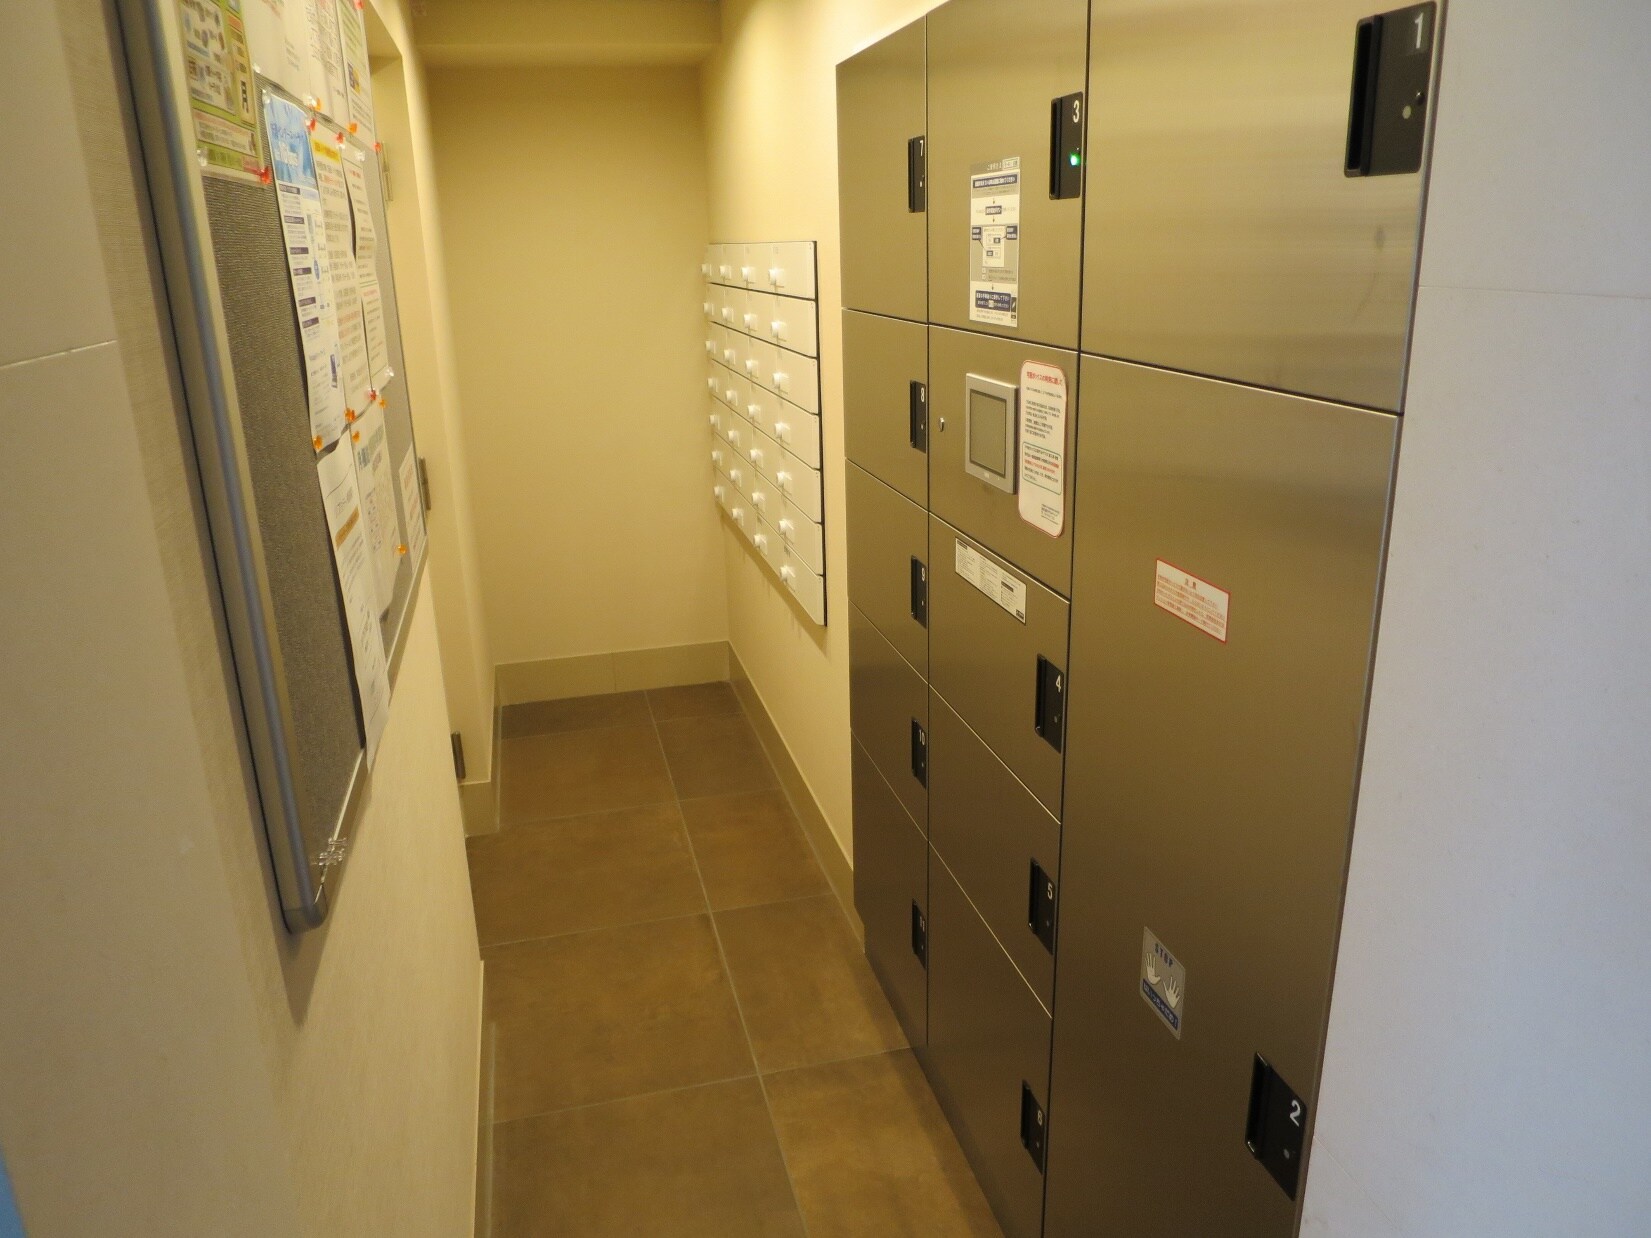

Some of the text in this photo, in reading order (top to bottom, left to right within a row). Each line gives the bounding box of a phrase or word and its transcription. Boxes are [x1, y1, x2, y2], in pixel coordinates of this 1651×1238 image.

[1414, 12, 1424, 49] 1
[1072, 99, 1080, 123] 3
[919, 139, 924, 157] 7
[920, 387, 925, 403] 8
[921, 567, 926, 582] 9
[1055, 674, 1062, 693] 4
[918, 729, 926, 746] 10
[1047, 882, 1053, 900] 5
[1154, 942, 1174, 968] STOP
[1289, 1099, 1301, 1127] 2
